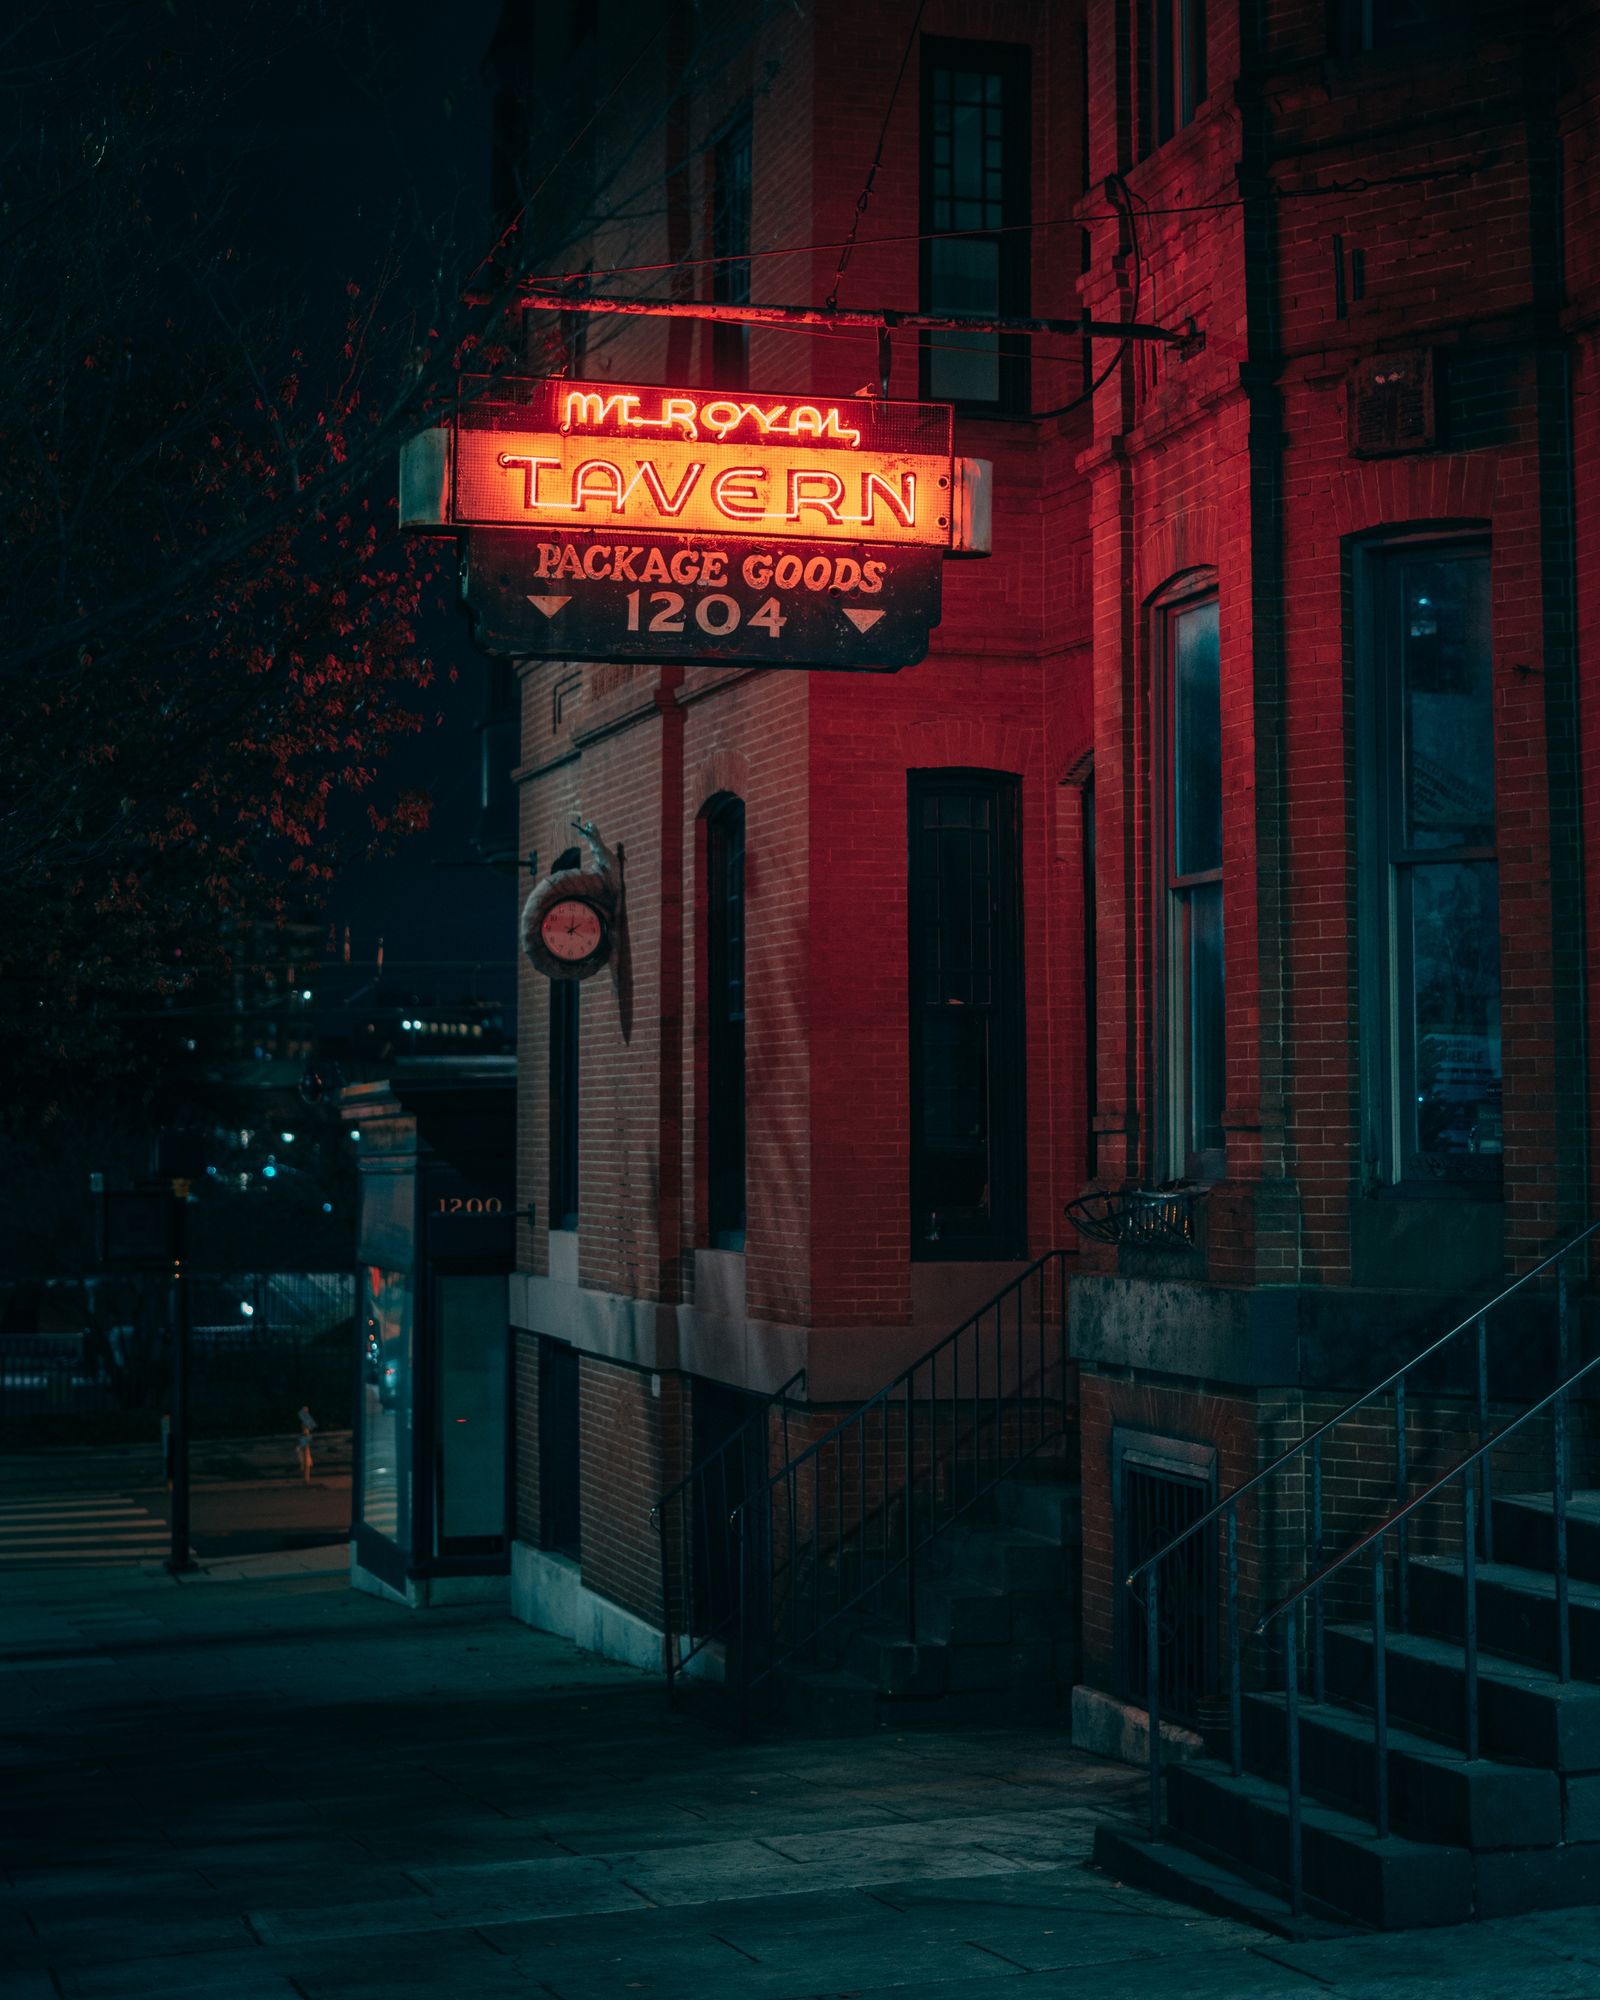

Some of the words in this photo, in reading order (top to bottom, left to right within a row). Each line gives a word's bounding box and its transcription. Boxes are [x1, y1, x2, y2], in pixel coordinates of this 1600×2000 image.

[663, 397, 861, 447] ROYAL
[499, 452, 919, 527] TAVERN
[533, 543, 729, 588] PACKAGE
[742, 551, 887, 594] GOODS
[626, 589, 788, 639] 1204
[438, 1197, 503, 1214] 1200
